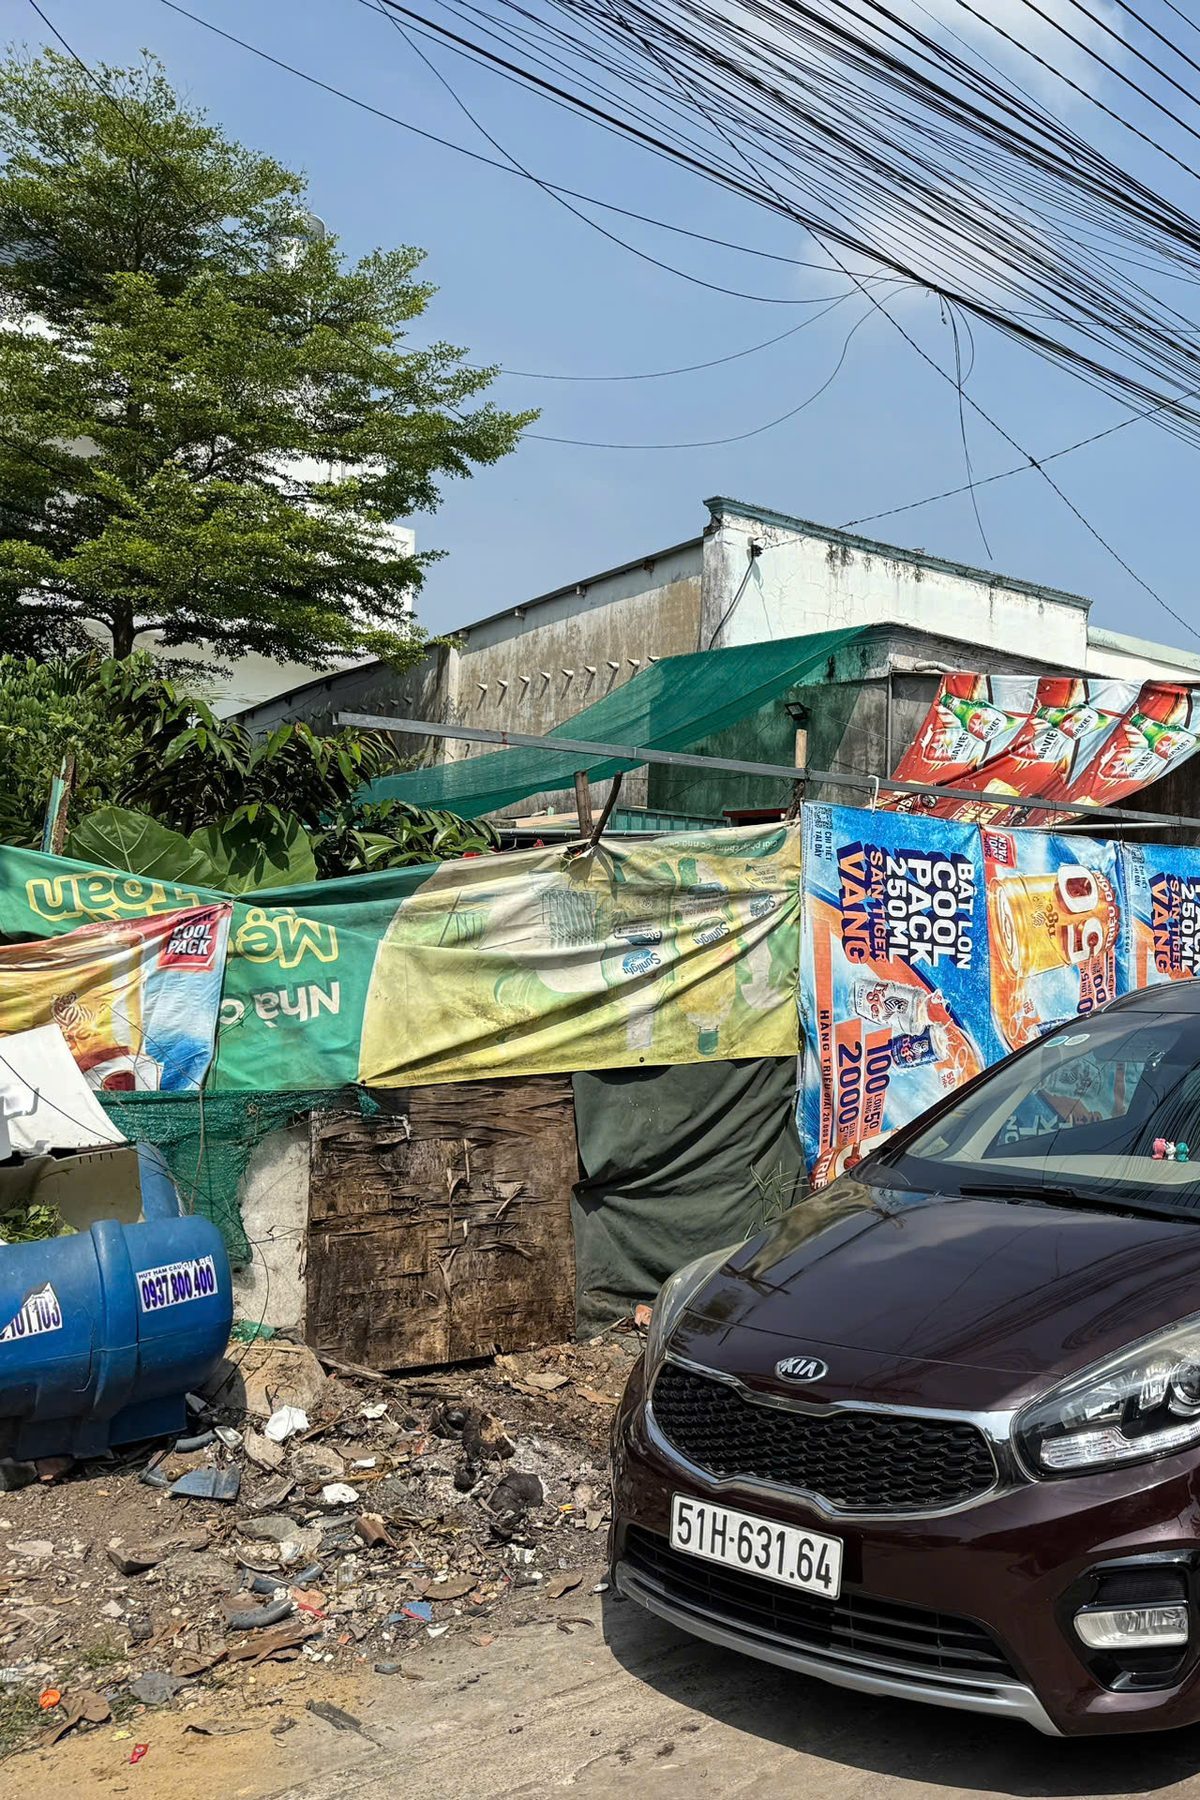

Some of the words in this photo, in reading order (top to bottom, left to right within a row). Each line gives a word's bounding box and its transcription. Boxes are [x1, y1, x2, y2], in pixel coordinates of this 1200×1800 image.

[813, 831, 822, 842] TẠI
[814, 843, 823, 858] ĐÂY
[825, 846, 833, 861] TIẾT
[998, 836, 1008, 863] PACK
[869, 851, 886, 903] SĂN
[953, 863, 976, 916] BẬT
[838, 850, 870, 964] VÀNG
[886, 855, 908, 964] 250ML
[907, 858, 932, 964] PACK
[931, 861, 958, 966] COOL
[1057, 864, 1105, 963] 50
[1170, 880, 1181, 920] SĂN
[167, 938, 211, 956] PACK
[171, 923, 213, 940] COOL
[236, 906, 339, 968] Mẹ
[693, 921, 730, 945] Sunlight
[872, 907, 888, 963] TIGER
[956, 921, 974, 969] LON
[1104, 906, 1117, 949] TRIỆU
[1152, 880, 1172, 974] VÀNG
[1172, 927, 1181, 972] TIGER
[1181, 883, 1193, 973] 250ML
[623, 952, 661, 975] Sunlight
[254, 980, 341, 1028] Nhà
[820, 1010, 831, 1051] HÀNG
[822, 1058, 833, 1090] TRIỆU
[838, 1040, 862, 1124] 2000
[865, 1039, 892, 1094] 100
[946, 1072, 954, 1085] 50
[864, 1113, 881, 1129] 50
[872, 1094, 882, 1111] LON
[811, 1154, 833, 1189] TRIỆ
[142, 1263, 214, 1310] 0937.800.400
[781, 1358, 817, 1377] KIA
[677, 1501, 832, 1589] 51H-631.64
